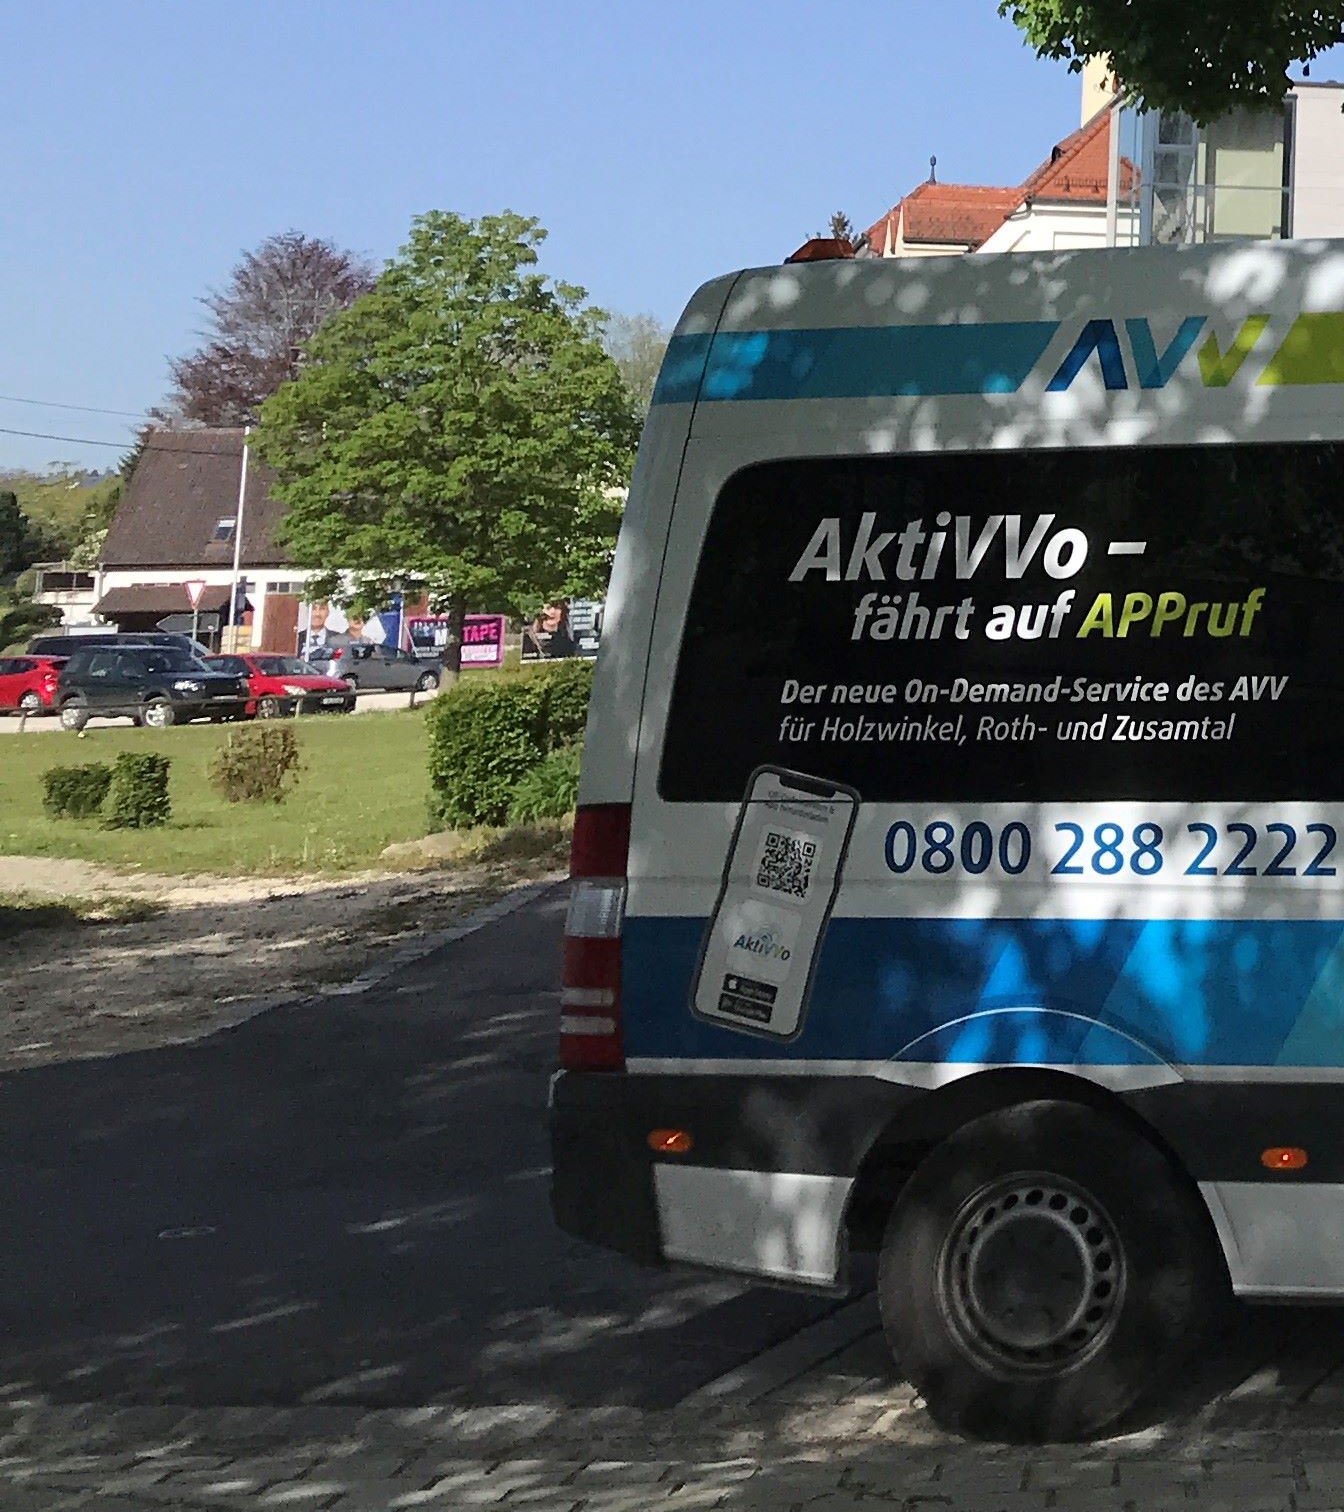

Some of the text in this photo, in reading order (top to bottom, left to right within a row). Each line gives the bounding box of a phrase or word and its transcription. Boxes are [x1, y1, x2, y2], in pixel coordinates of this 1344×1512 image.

[788, 511, 1088, 581] AktiVVo
[851, 588, 1266, 640] fährt auf APPruf
[780, 675, 1289, 704] Der neue On-Demand-Service des AVV
[778, 712, 1236, 746] für Holzwinkel, Roth- und Zusamtal
[884, 820, 1337, 877] 0800 288 2222
[733, 934, 791, 961] AktiVVo
